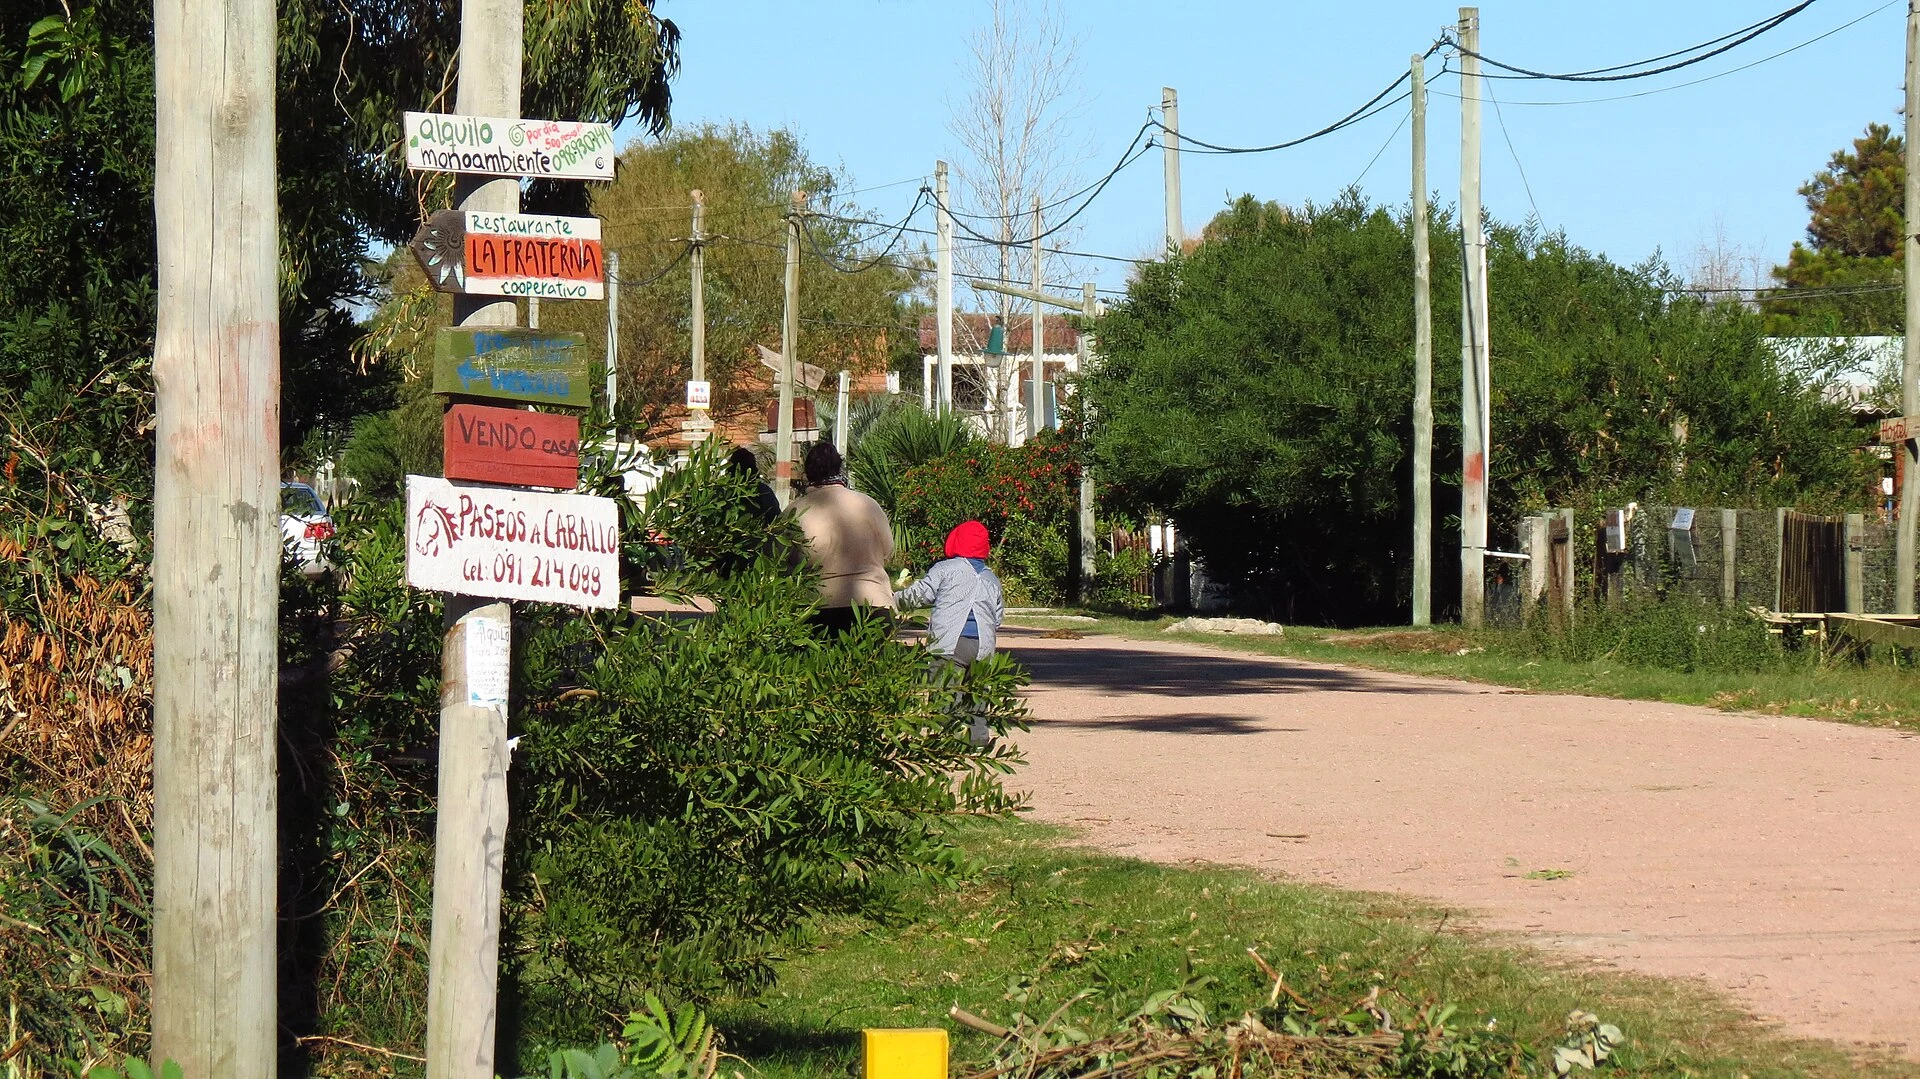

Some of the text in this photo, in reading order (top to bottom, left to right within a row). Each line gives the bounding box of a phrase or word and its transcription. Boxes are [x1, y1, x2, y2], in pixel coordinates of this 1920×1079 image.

[419, 115, 493, 152] alquilo
[545, 137, 561, 150] 500
[421, 146, 551, 172] monoambiente
[472, 214, 572, 235] Restaurante
[472, 239, 598, 277] LA FRATERNA
[501, 279, 587, 297] cooperativo
[457, 413, 536, 450] VENDO
[1881, 421, 1908, 440] Hostel
[459, 495, 616, 554] PASEOS A CABALLO
[493, 554, 523, 585] 091
[531, 556, 565, 588] 214
[569, 564, 602, 597] 088
